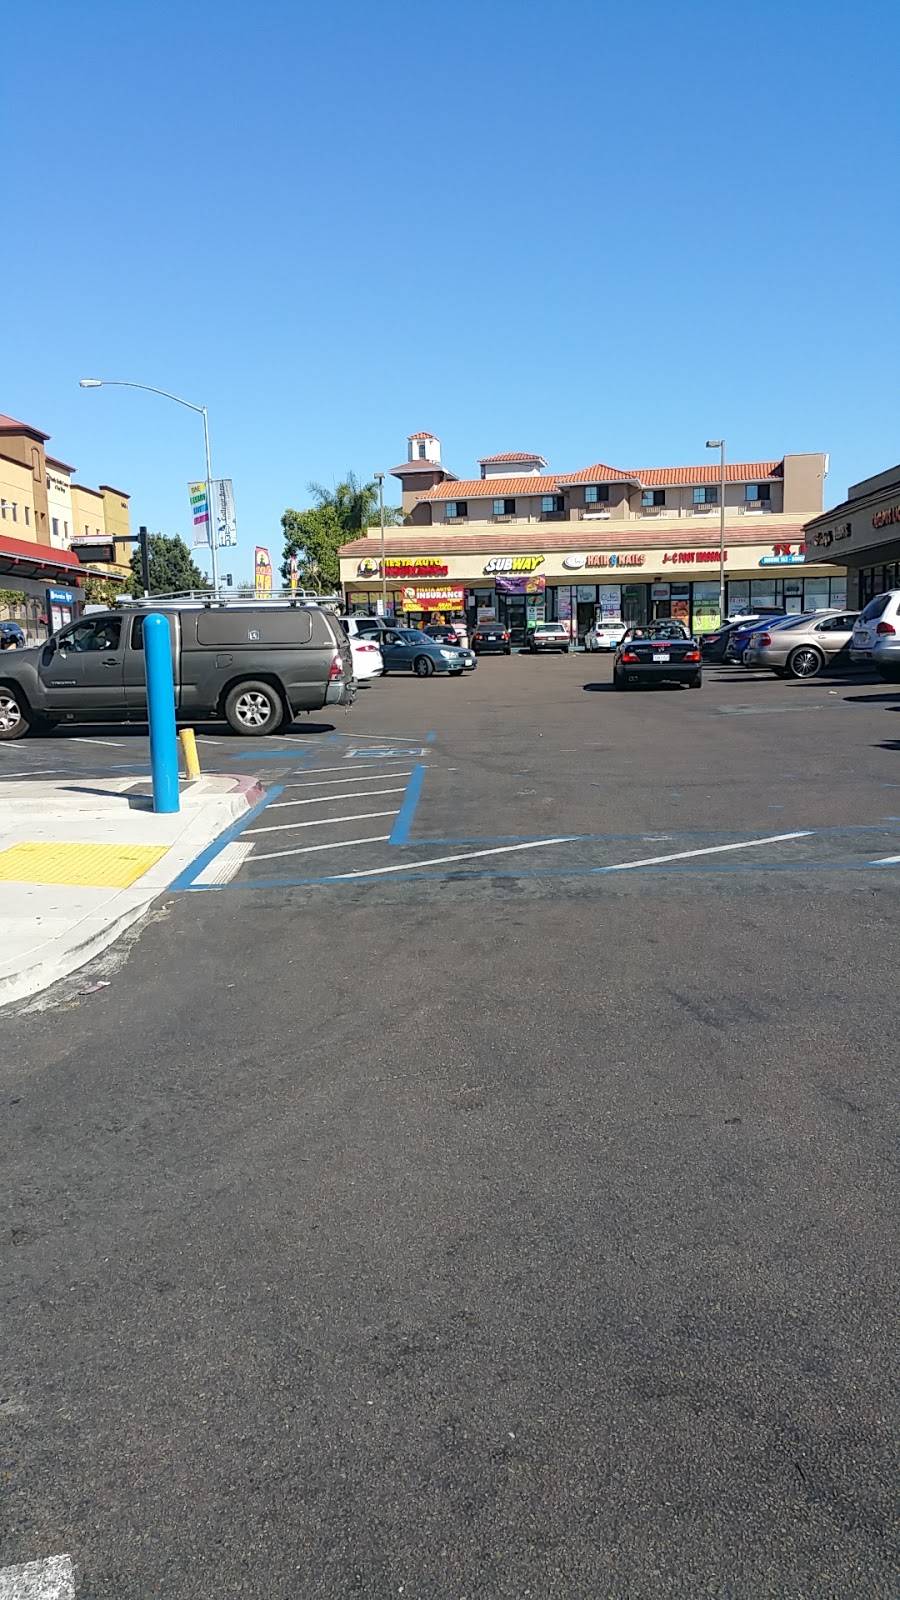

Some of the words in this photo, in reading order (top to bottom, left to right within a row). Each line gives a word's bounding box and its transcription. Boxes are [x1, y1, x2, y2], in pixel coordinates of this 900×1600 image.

[415, 558, 442, 566] AUTO
[486, 556, 545, 572] SUBWAY
[587, 555, 609, 566] HAIR
[618, 554, 646, 565] NAILS
[416, 591, 463, 599] INSURANCE
